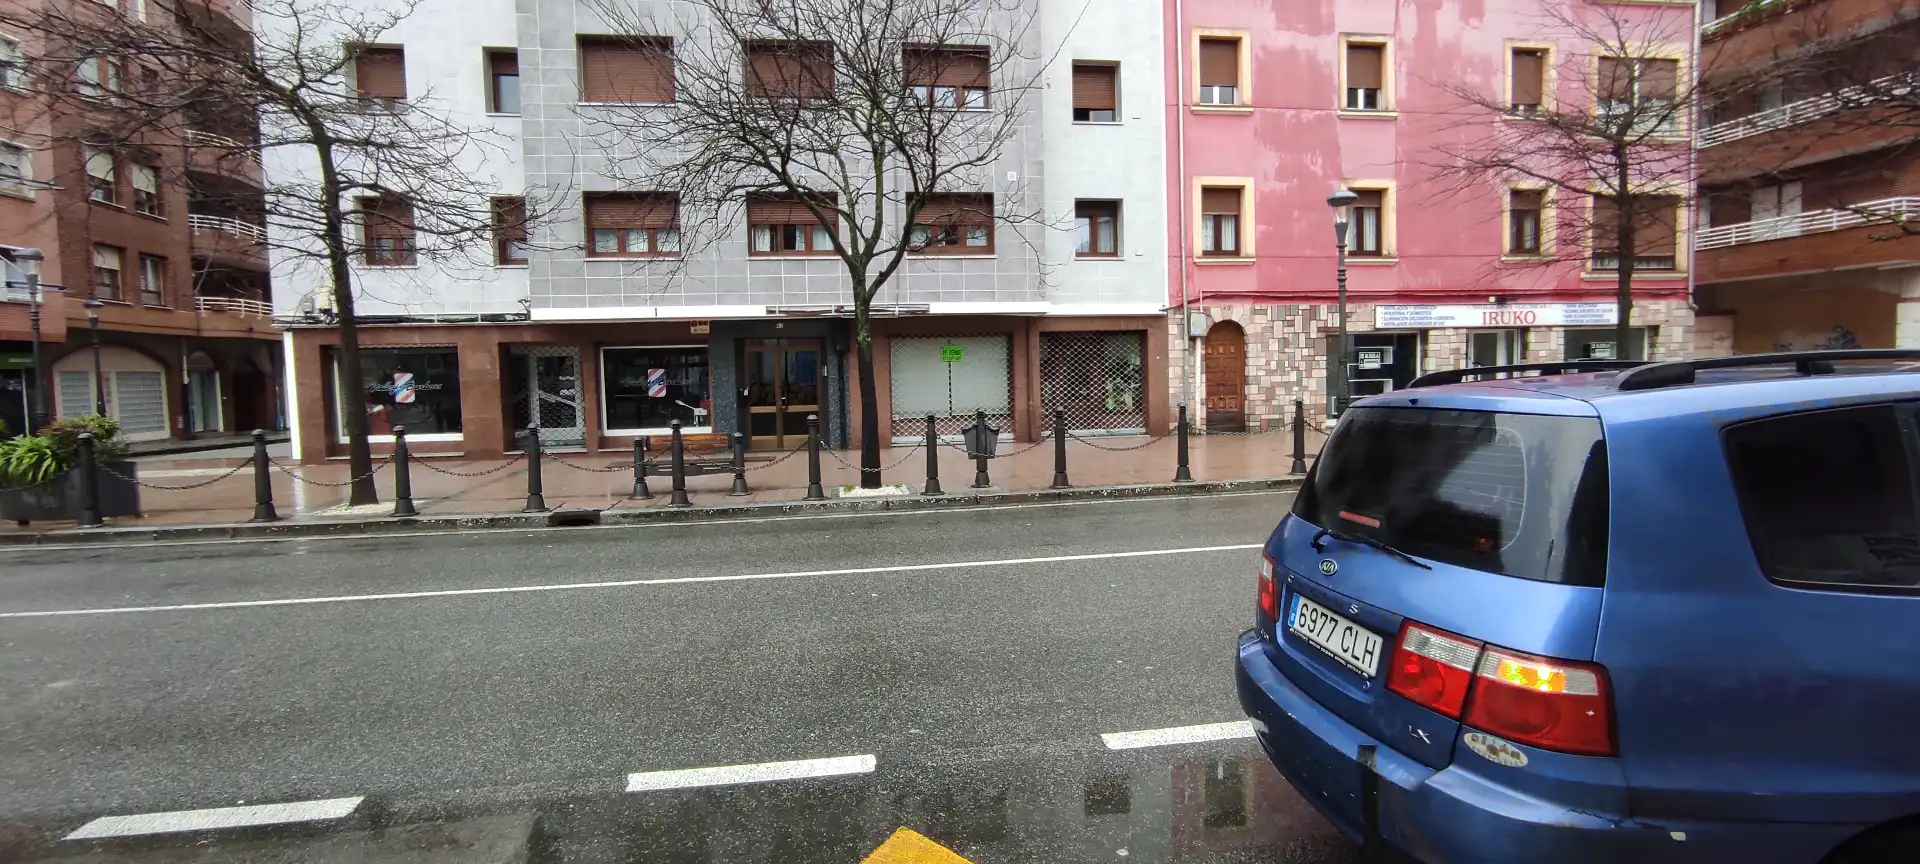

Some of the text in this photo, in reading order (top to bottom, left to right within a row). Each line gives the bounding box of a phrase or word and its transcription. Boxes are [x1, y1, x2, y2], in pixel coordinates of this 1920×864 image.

[1482, 310, 1536, 325] IRUKO
[1320, 560, 1337, 574] KIA
[1298, 603, 1339, 643] 6977
[1340, 625, 1377, 669] CLH
[1408, 724, 1431, 745] LX
